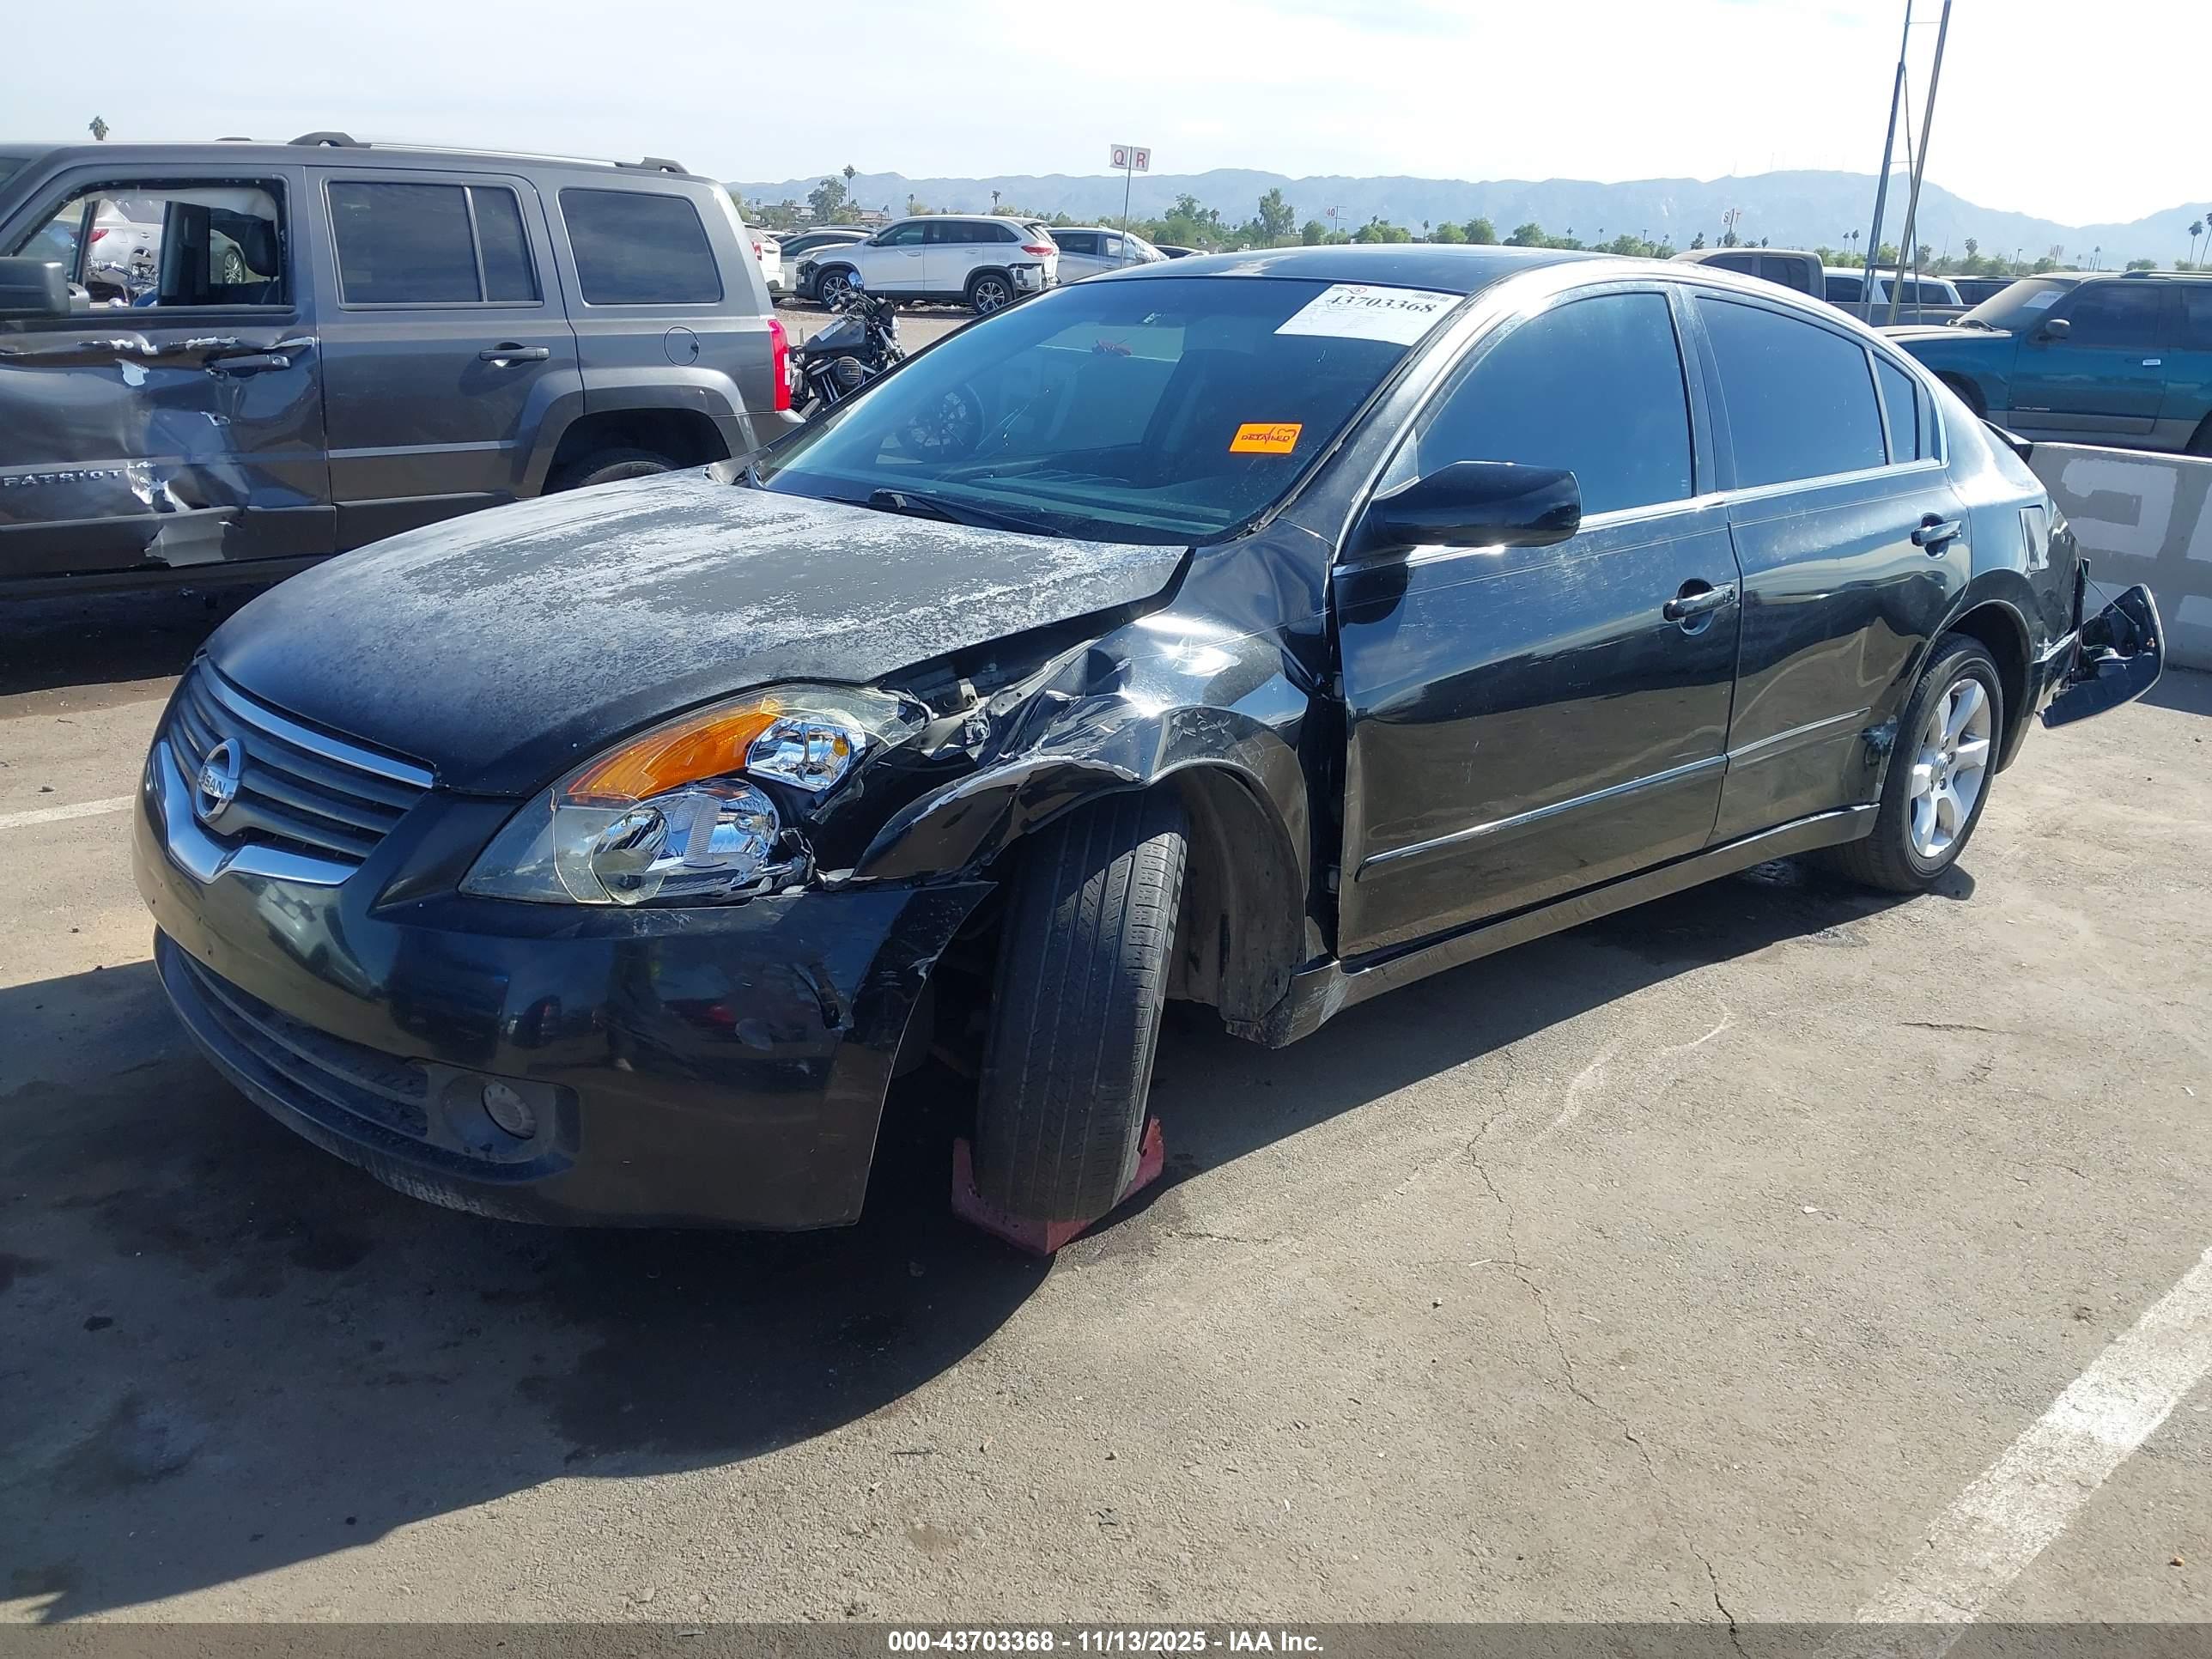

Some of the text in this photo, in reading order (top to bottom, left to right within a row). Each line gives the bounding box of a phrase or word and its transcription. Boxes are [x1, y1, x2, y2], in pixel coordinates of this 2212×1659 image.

[1114, 149, 1124, 165] Q
[1136, 152, 1146, 167] R
[1326, 208, 1335, 217] 40
[1723, 211, 1729, 223] S
[1326, 295, 1437, 313] 43703368
[3, 469, 123, 487] PATRIOT
